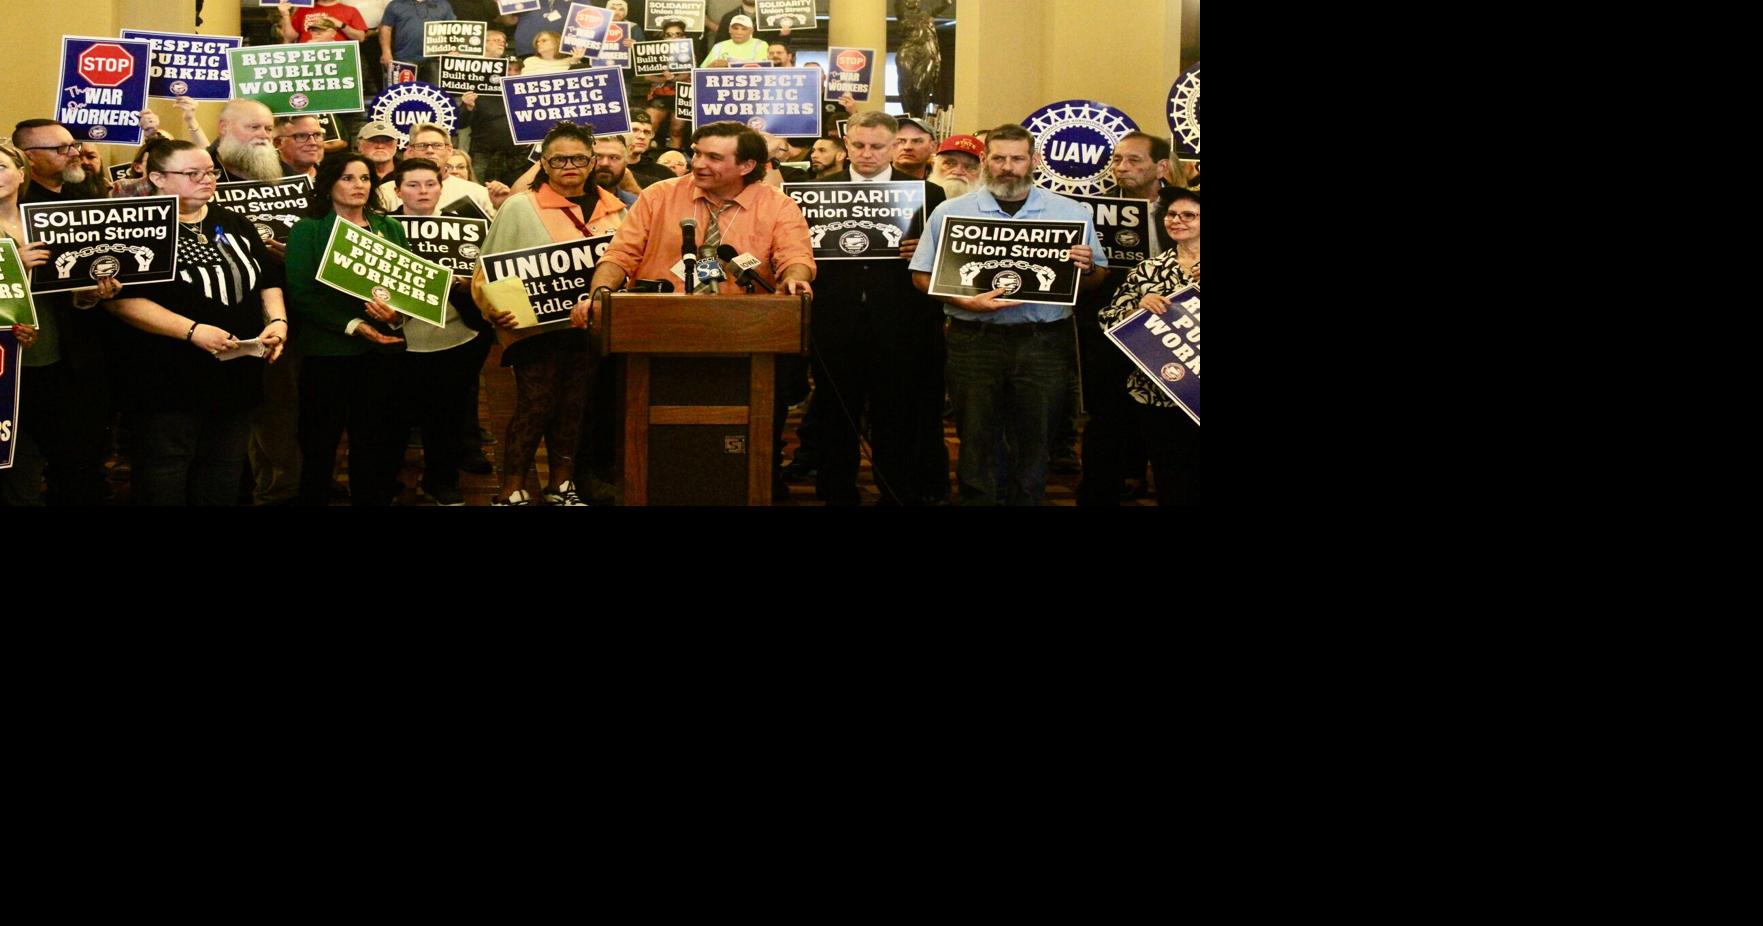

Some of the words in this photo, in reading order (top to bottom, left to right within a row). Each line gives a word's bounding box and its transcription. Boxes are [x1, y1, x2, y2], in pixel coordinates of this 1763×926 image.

[428, 24, 482, 35] UNIONS
[136, 38, 230, 54] ESPECT
[636, 42, 688, 56] UNIONS
[84, 56, 129, 72] STOP
[242, 48, 346, 66] RESPECT
[637, 55, 657, 63] Built
[839, 56, 863, 64] STOP
[150, 66, 230, 81] ORKERS
[254, 64, 337, 80] PUBLIC
[444, 58, 504, 73] UNIONS
[638, 64, 667, 72] Middle
[442, 71, 465, 80] Built
[468, 73, 485, 81] the
[706, 74, 807, 89] RESPECT
[238, 77, 355, 95] WORKERS
[442, 80, 475, 90] Middle
[513, 74, 609, 95] RESPECT
[86, 88, 123, 105] WAR
[526, 88, 604, 107] PUBLIC
[717, 90, 799, 101] PUBLIC
[61, 108, 140, 126] WORKERS
[515, 101, 621, 122] WORKERS
[701, 103, 814, 116] WORKERS
[396, 110, 432, 126] UAW
[1050, 140, 1105, 164] UAW
[208, 182, 304, 203] LIDARITY
[790, 190, 916, 204] SOLIDARITY
[248, 197, 308, 214] Strong
[852, 206, 913, 219] Strong
[33, 205, 171, 228] SOLIDARITY
[39, 227, 100, 245] Union
[104, 224, 167, 241] Strong
[401, 221, 480, 242] IONS
[950, 224, 1078, 245] SOLIDARITY
[345, 228, 440, 281] RESPECT
[418, 241, 449, 253] the
[951, 241, 1006, 256] Union
[1010, 246, 1071, 262] Strong
[1102, 246, 1144, 260] lass
[350, 246, 426, 290] PUBLIC
[439, 257, 476, 272] Clas
[333, 250, 440, 306] WORKERS
[525, 282, 548, 296] ilt
[552, 277, 585, 291] the
[532, 298, 573, 315] ddle
[1144, 314, 1200, 375] WORK
